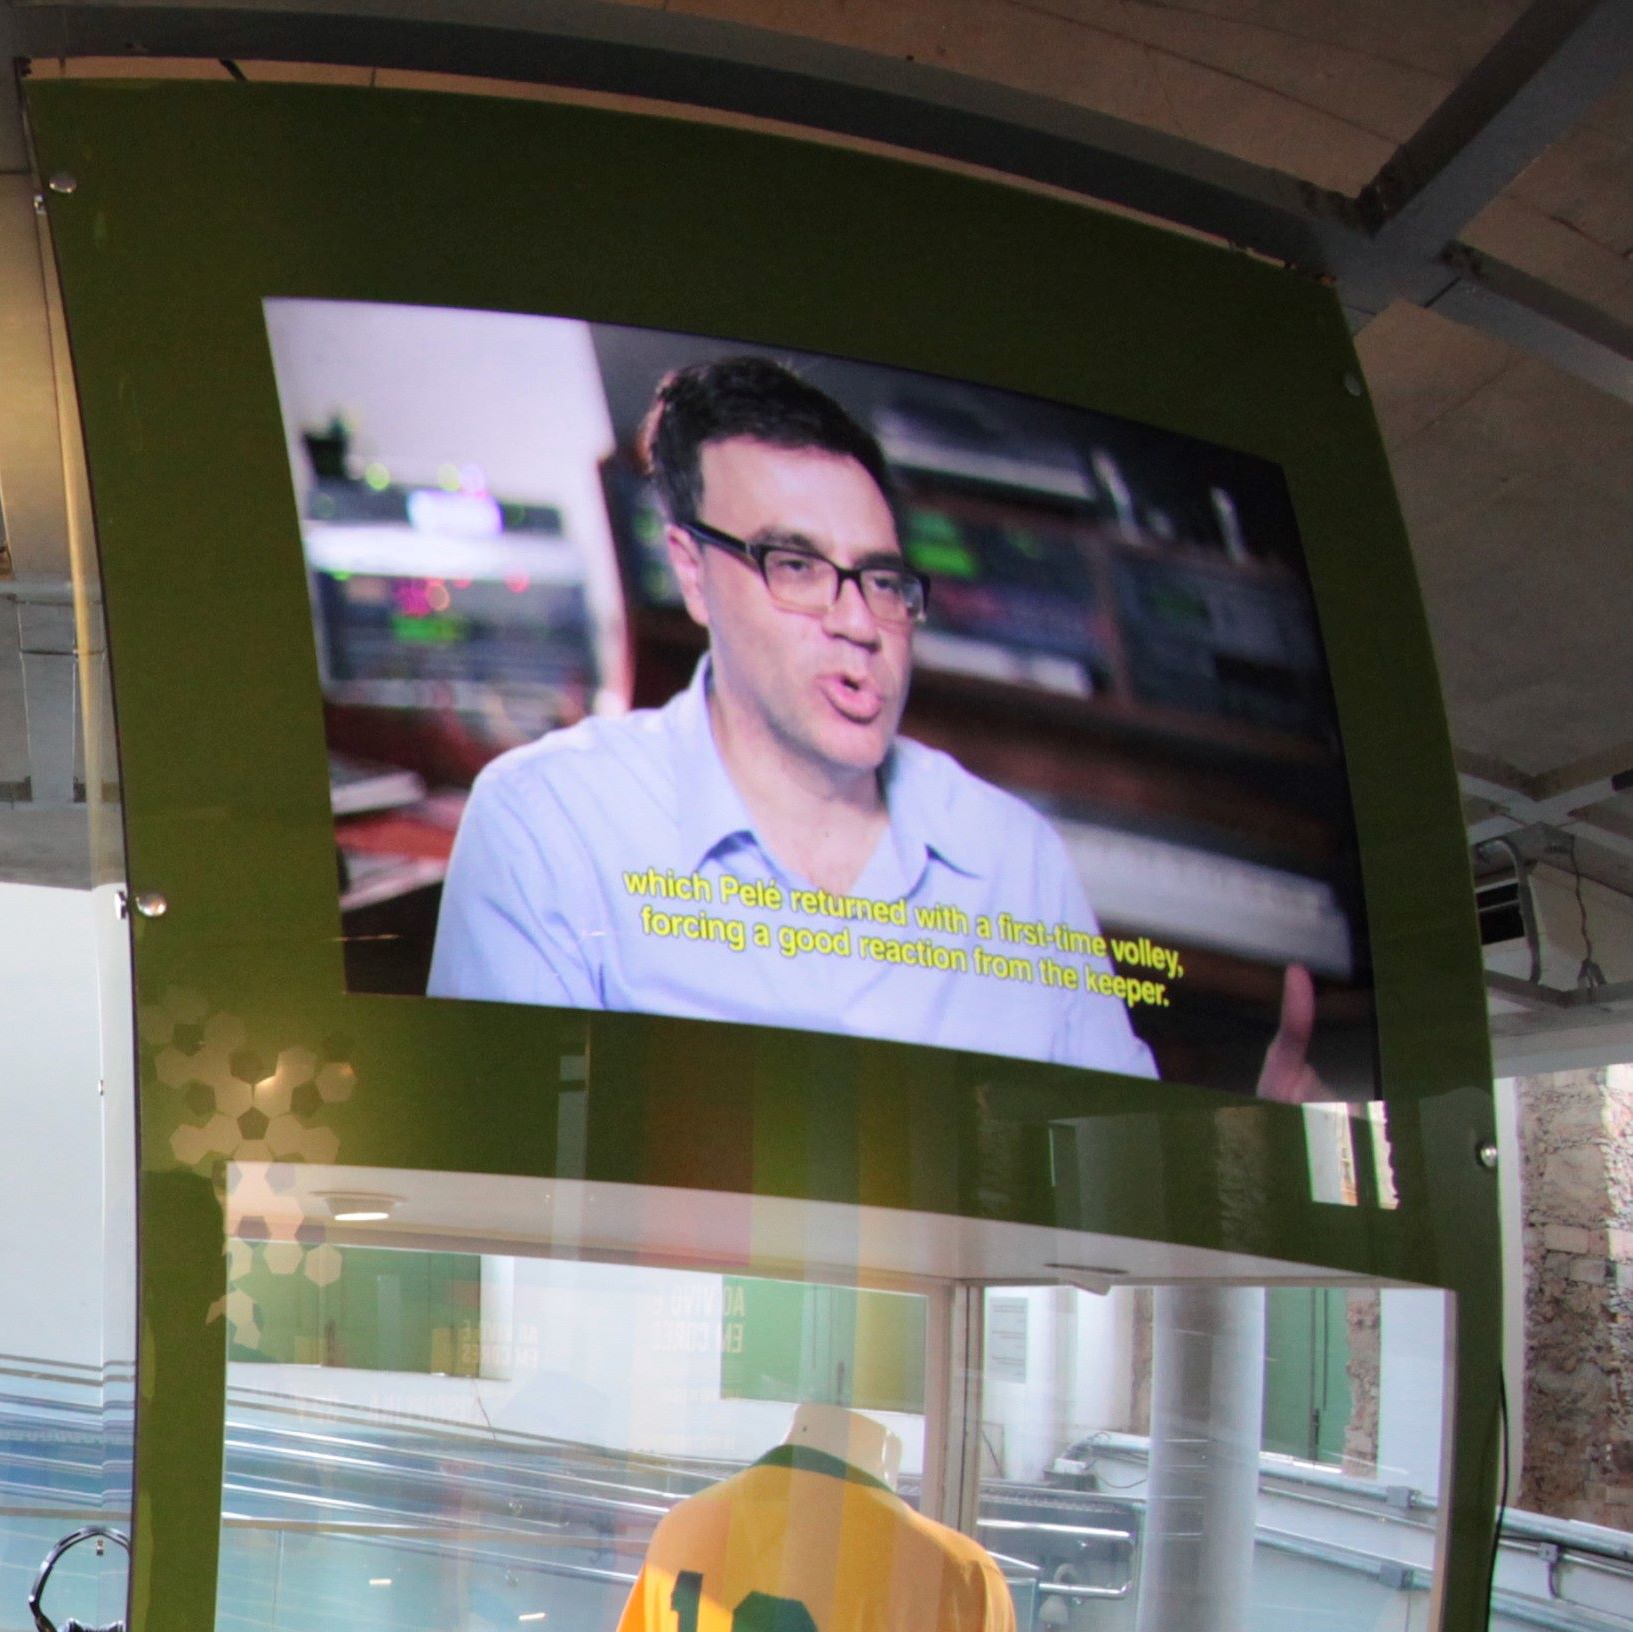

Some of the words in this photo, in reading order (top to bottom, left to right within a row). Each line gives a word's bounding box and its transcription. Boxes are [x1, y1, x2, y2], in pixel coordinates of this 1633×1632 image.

[623, 866, 712, 903] which
[719, 874, 783, 910] Pelé
[790, 888, 909, 927] returned
[914, 901, 969, 936] with
[975, 915, 992, 940] a
[998, 912, 1108, 958] first-time
[1110, 935, 1185, 980] volley,
[640, 905, 746, 952] forcing
[753, 922, 771, 948] a
[778, 924, 852, 958] good
[858, 934, 968, 974] reaction
[973, 946, 1033, 983] from
[1038, 957, 1080, 990] the
[1085, 963, 1171, 1008] keeper.
